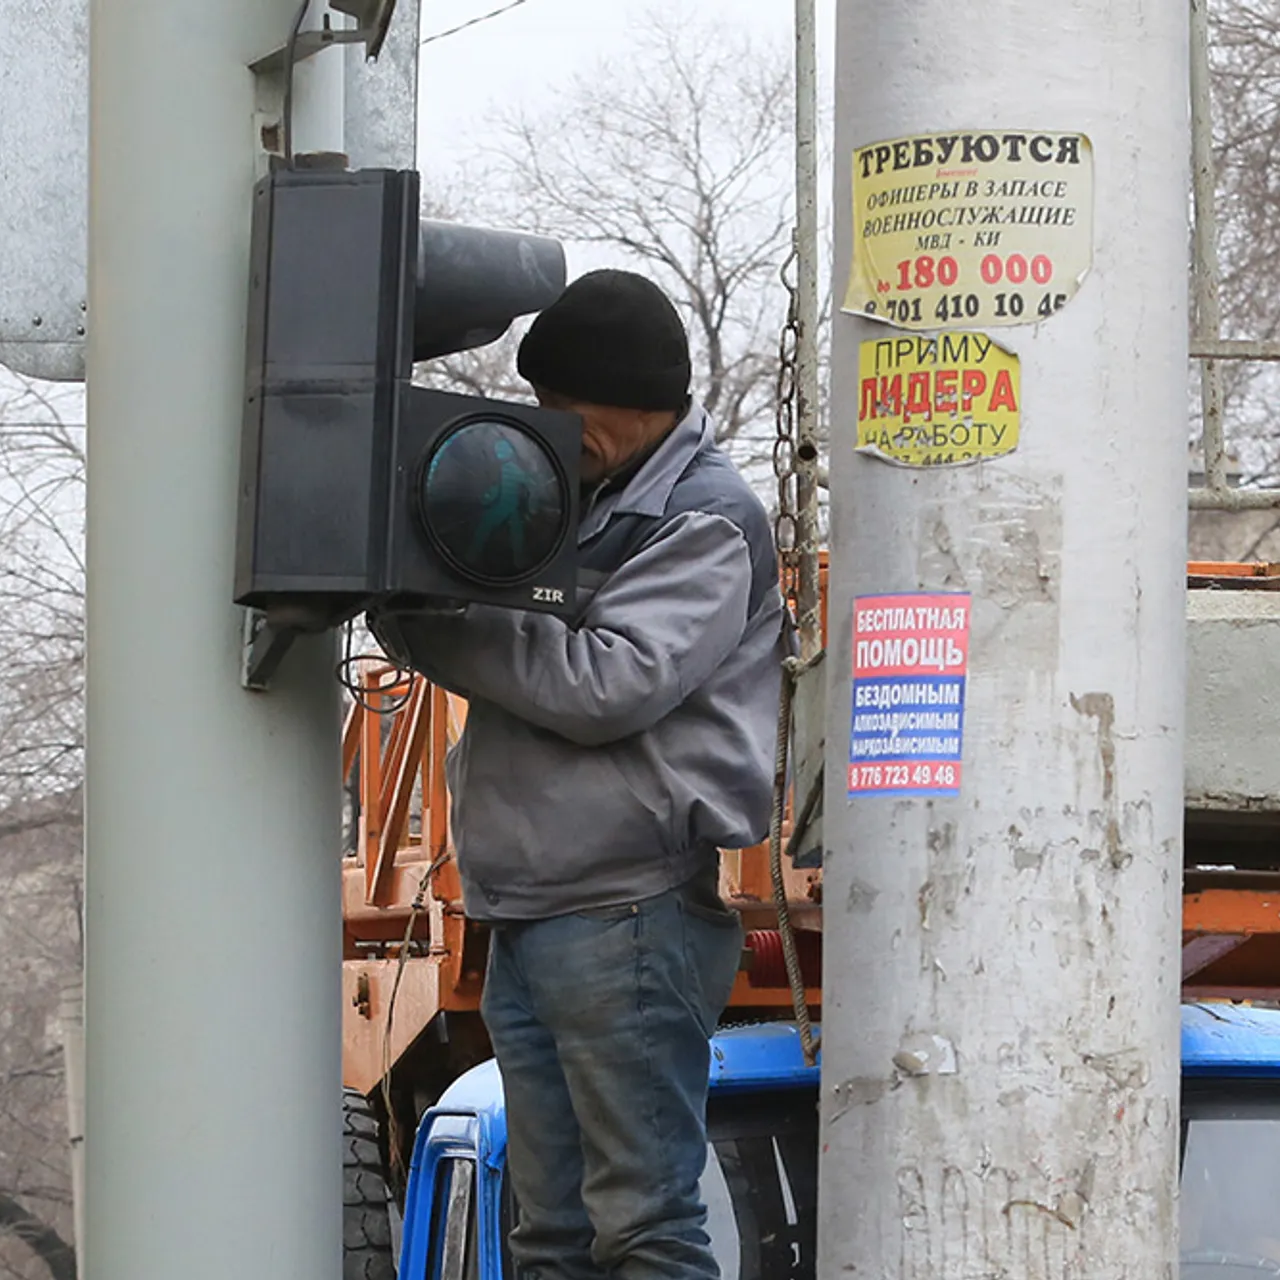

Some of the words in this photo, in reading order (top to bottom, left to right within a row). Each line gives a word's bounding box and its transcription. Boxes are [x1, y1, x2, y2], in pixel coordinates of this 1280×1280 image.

[858, 133, 1081, 178] ТРЕБУЮТСЯ
[866, 181, 959, 211] ОФИЦЕРЫ
[965, 181, 979, 198] В
[983, 180, 1068, 199] ЗАПАСЕ
[862, 206, 1076, 238] ВОЕННОСЛУЖАЩИЕ
[914, 233, 952, 251] МВД
[973, 231, 1002, 247] КИ
[896, 255, 959, 291] 180
[980, 253, 1053, 285] 000
[886, 297, 923, 322] 701
[935, 294, 980, 322] 410
[994, 293, 1024, 317] 10
[875, 334, 993, 370] ПРИМУ
[858, 369, 1018, 423] ЛИДЕРА
[896, 423, 1007, 448] РАБОТУ
[532, 587, 564, 603] ZIR
[856, 607, 966, 633] БЕСПЛАТНАЯ
[856, 637, 965, 671] ПОМОЩЬ
[855, 683, 960, 710] БЕЗДОМНЫМ
[885, 766, 909, 785] 723
[913, 765, 930, 785] 49
[934, 765, 955, 785] 48
